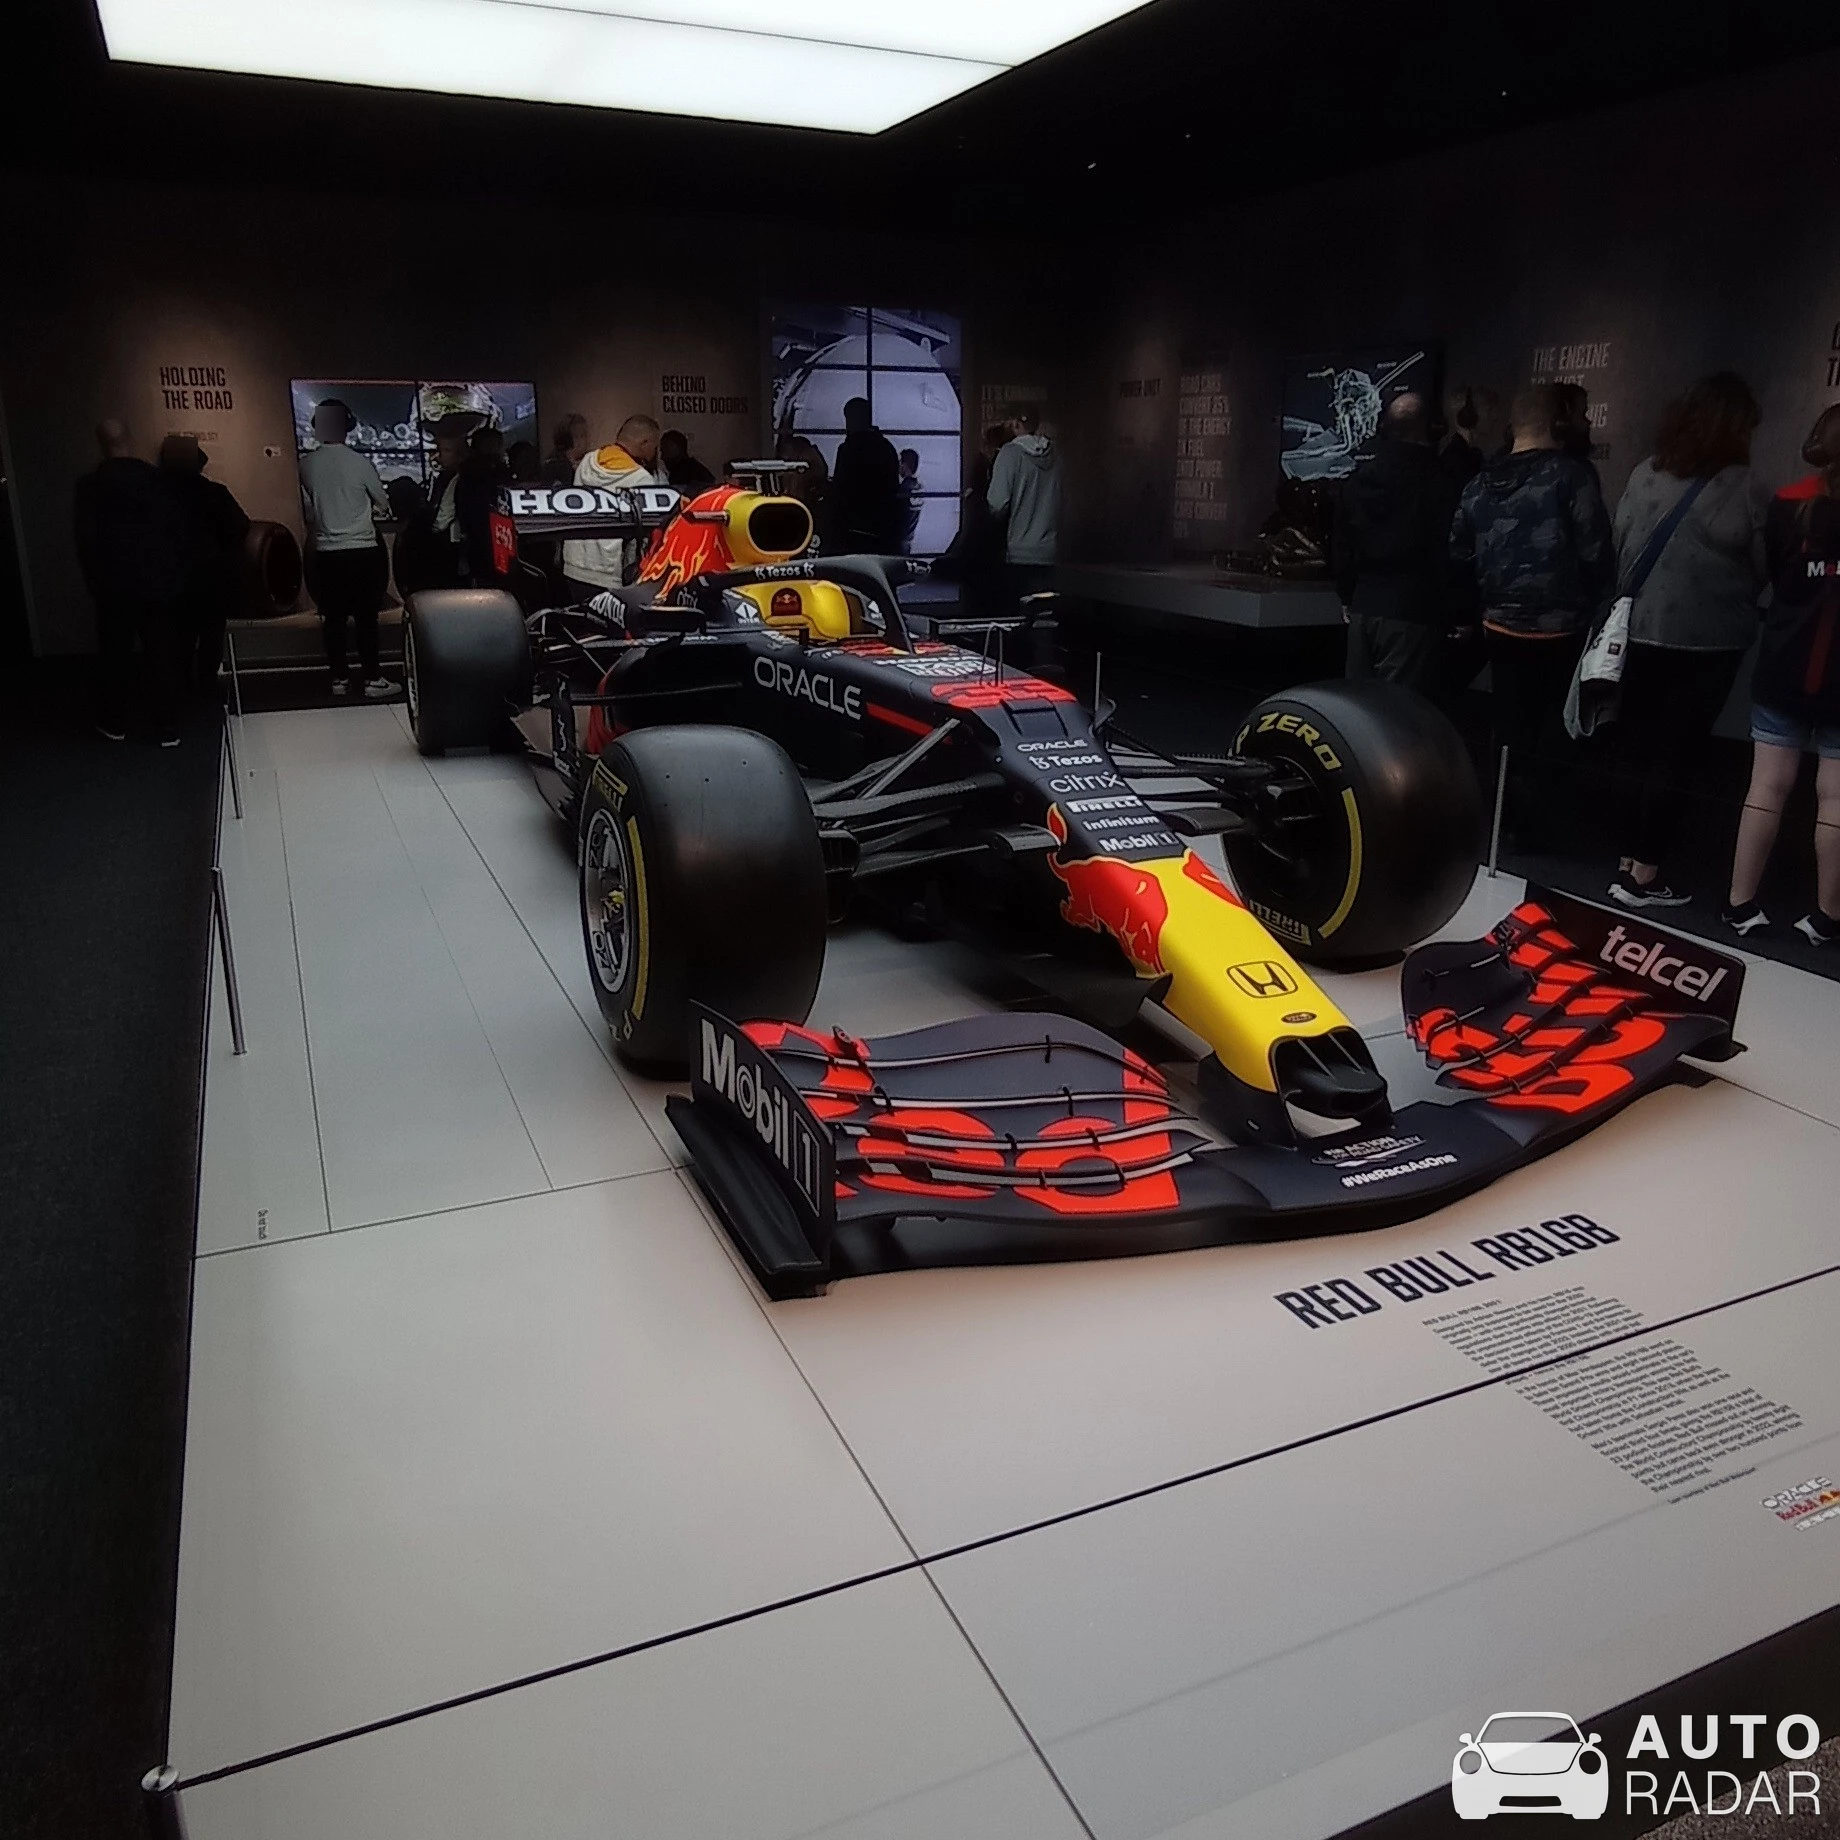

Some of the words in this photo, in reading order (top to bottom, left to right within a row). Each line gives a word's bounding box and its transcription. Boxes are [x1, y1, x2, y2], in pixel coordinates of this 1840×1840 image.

[1533, 347, 1556, 373] THE
[1558, 342, 1611, 370] ENGINE
[160, 366, 226, 387] HOLDING
[662, 375, 706, 393] BEHIND
[162, 390, 189, 410] THE
[193, 390, 233, 410] ROAD
[662, 395, 707, 414] CLOSED
[508, 488, 681, 515] HOND
[754, 656, 862, 721] ORACLE
[1017, 739, 1088, 753] ORACLE
[1256, 712, 1343, 772] ZERO
[1049, 753, 1104, 768] Tezos
[1050, 771, 1126, 793] citrix
[1099, 834, 1158, 852] Mobil
[1600, 925, 1728, 1002] telcel
[701, 1018, 789, 1169] Mobil
[1341, 1154, 1458, 1188] #WeRaceAsOne
[1275, 1279, 1383, 1330] RED
[1365, 1250, 1496, 1303] BULL
[1471, 1214, 1621, 1272] RB16B
[1762, 1476, 1832, 1510] ORACLE
